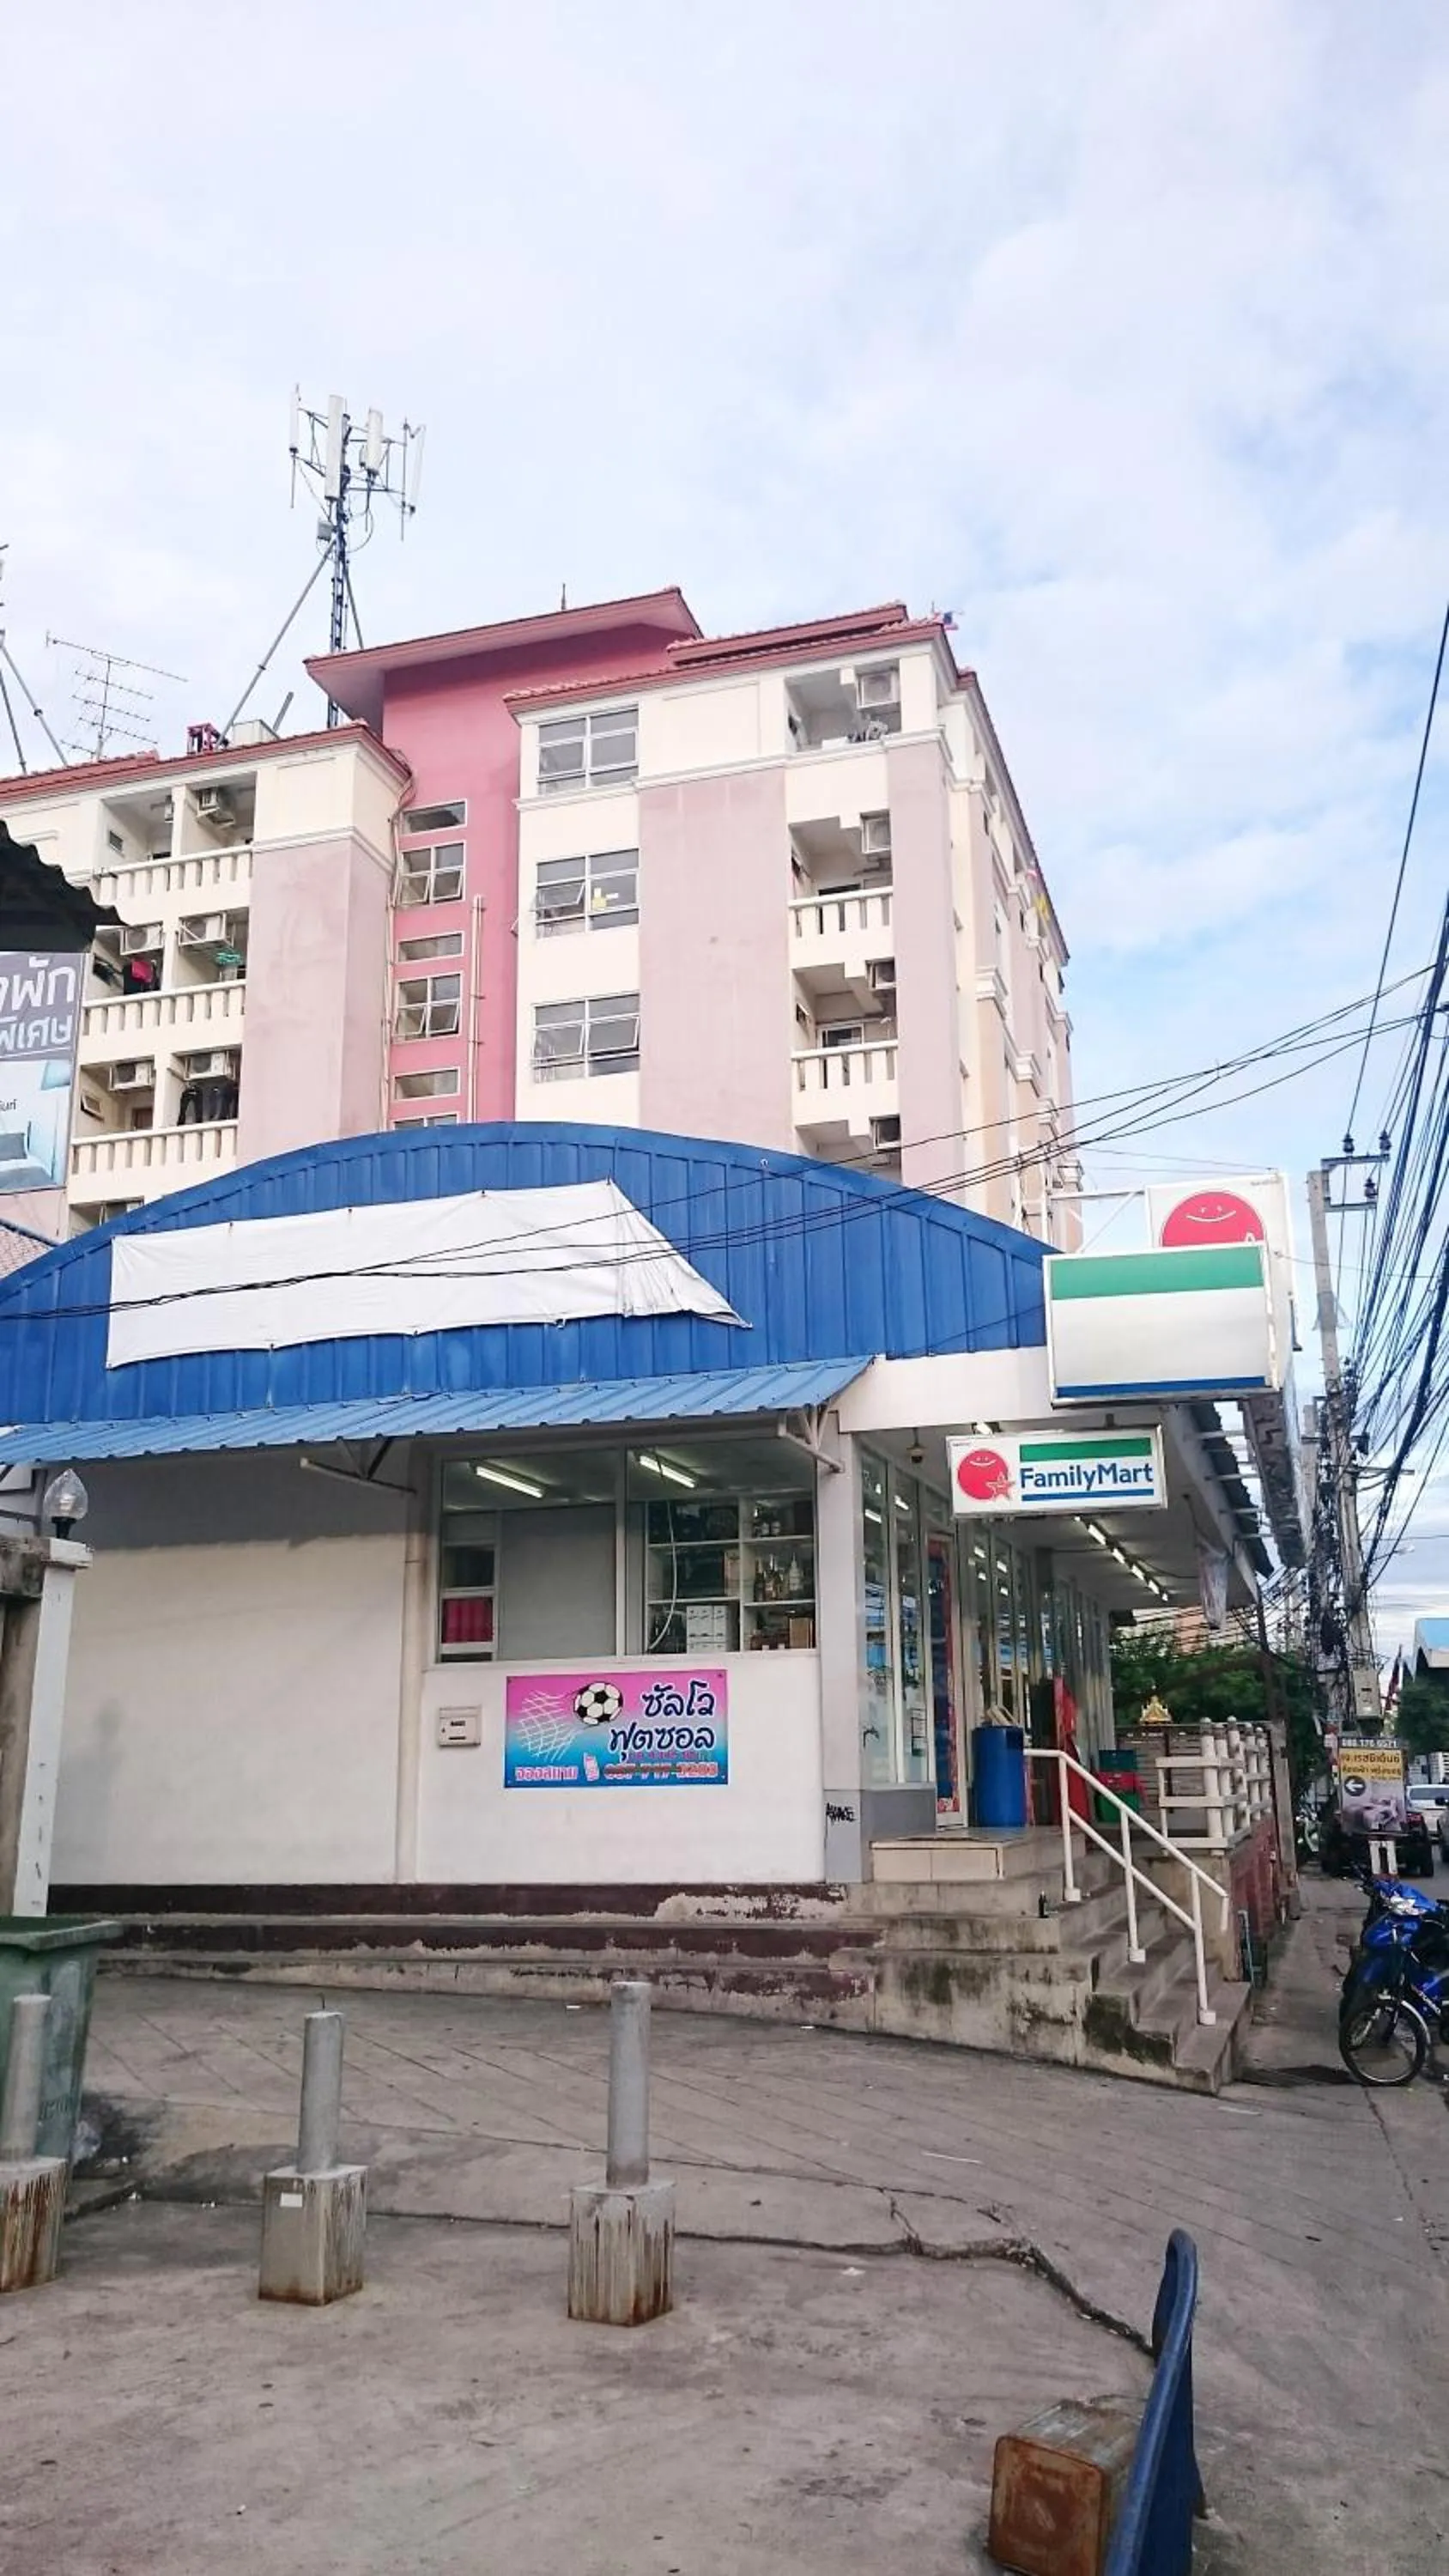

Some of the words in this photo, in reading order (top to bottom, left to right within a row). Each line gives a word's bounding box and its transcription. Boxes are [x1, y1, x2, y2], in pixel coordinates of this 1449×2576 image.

[1020, 1462, 1154, 1491] FamilyMart
[641, 1680, 715, 1716] ซัลโว
[609, 1722, 715, 1760] ฟุตซอล
